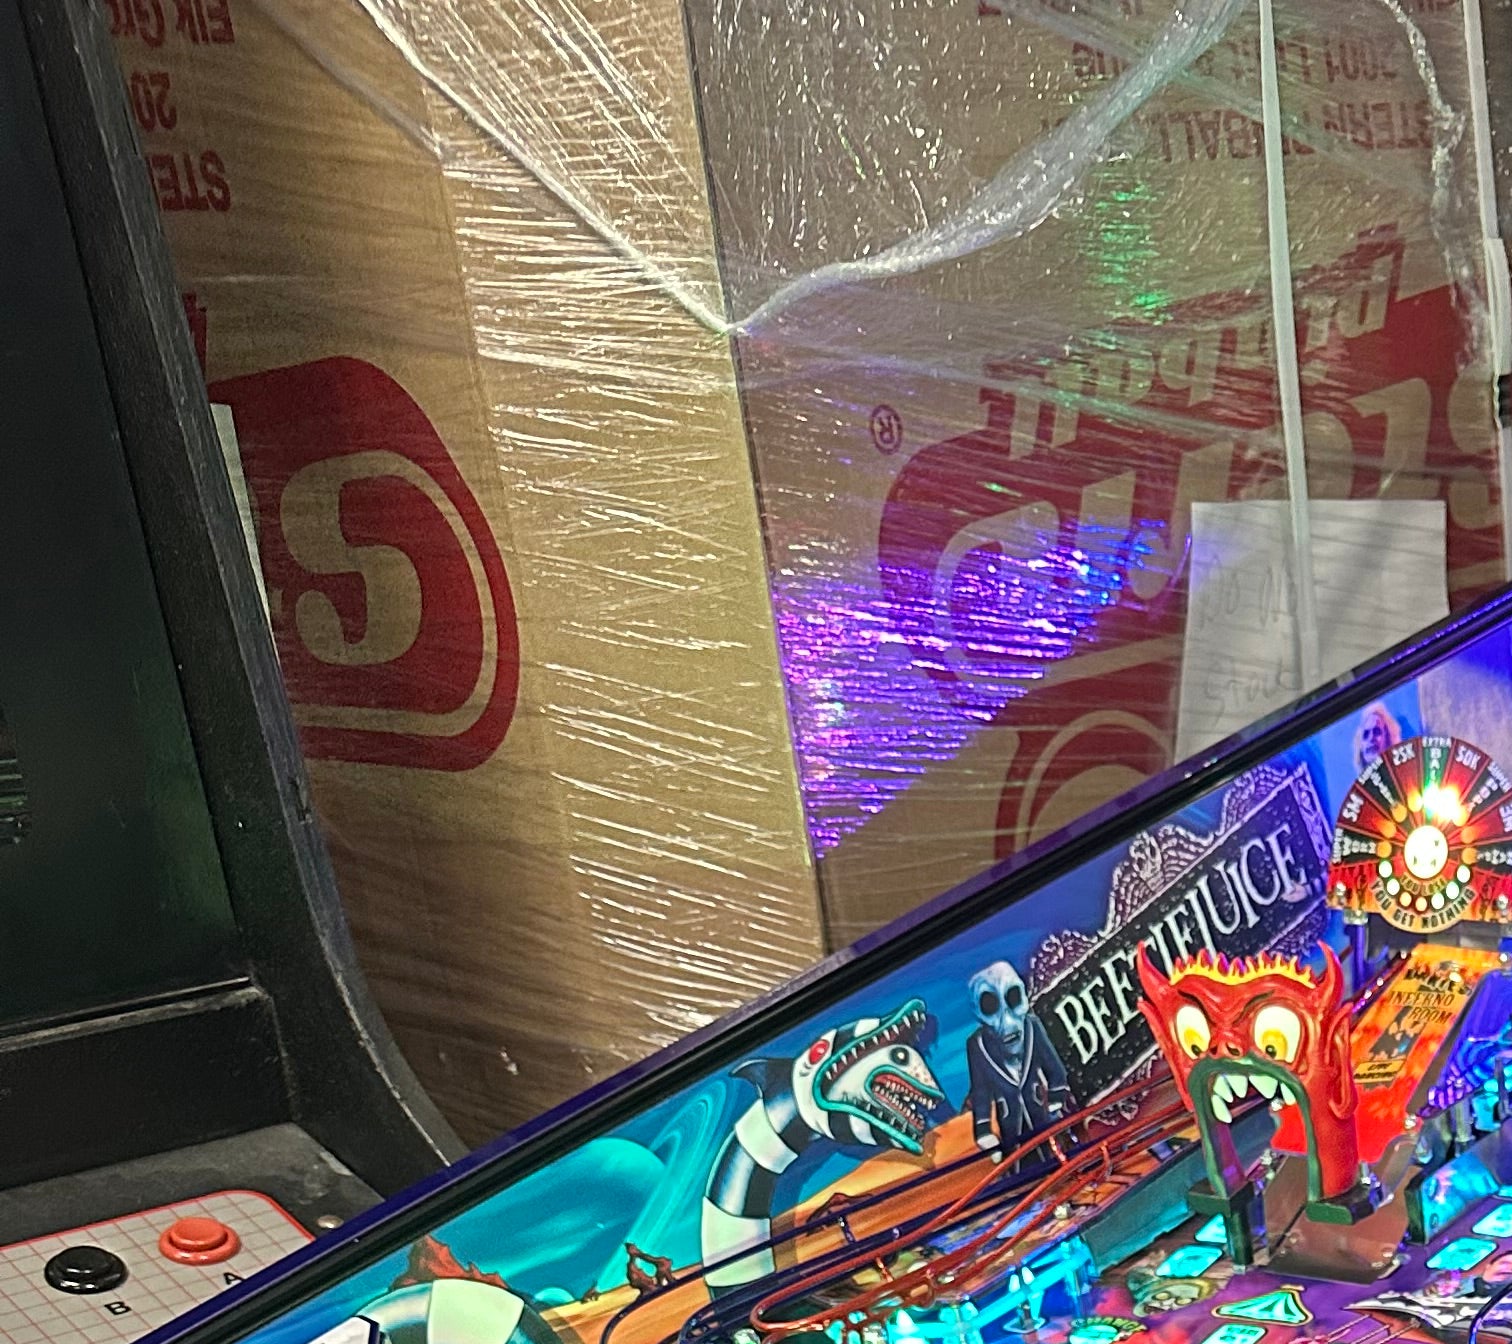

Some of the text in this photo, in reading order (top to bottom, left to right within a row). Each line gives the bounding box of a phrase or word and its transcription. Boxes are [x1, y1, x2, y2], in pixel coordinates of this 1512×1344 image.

[146, 150, 231, 212] STE
[1391, 743, 1416, 766] 25K
[1430, 749, 1443, 783] BAL
[1371, 877, 1393, 914] YOU
[1421, 887, 1477, 929] NOTHING
[1390, 990, 1456, 1007] INFERNO
[1407, 1006, 1453, 1025] ROOM
[223, 1271, 245, 1287] A
[105, 1301, 131, 1316] B
